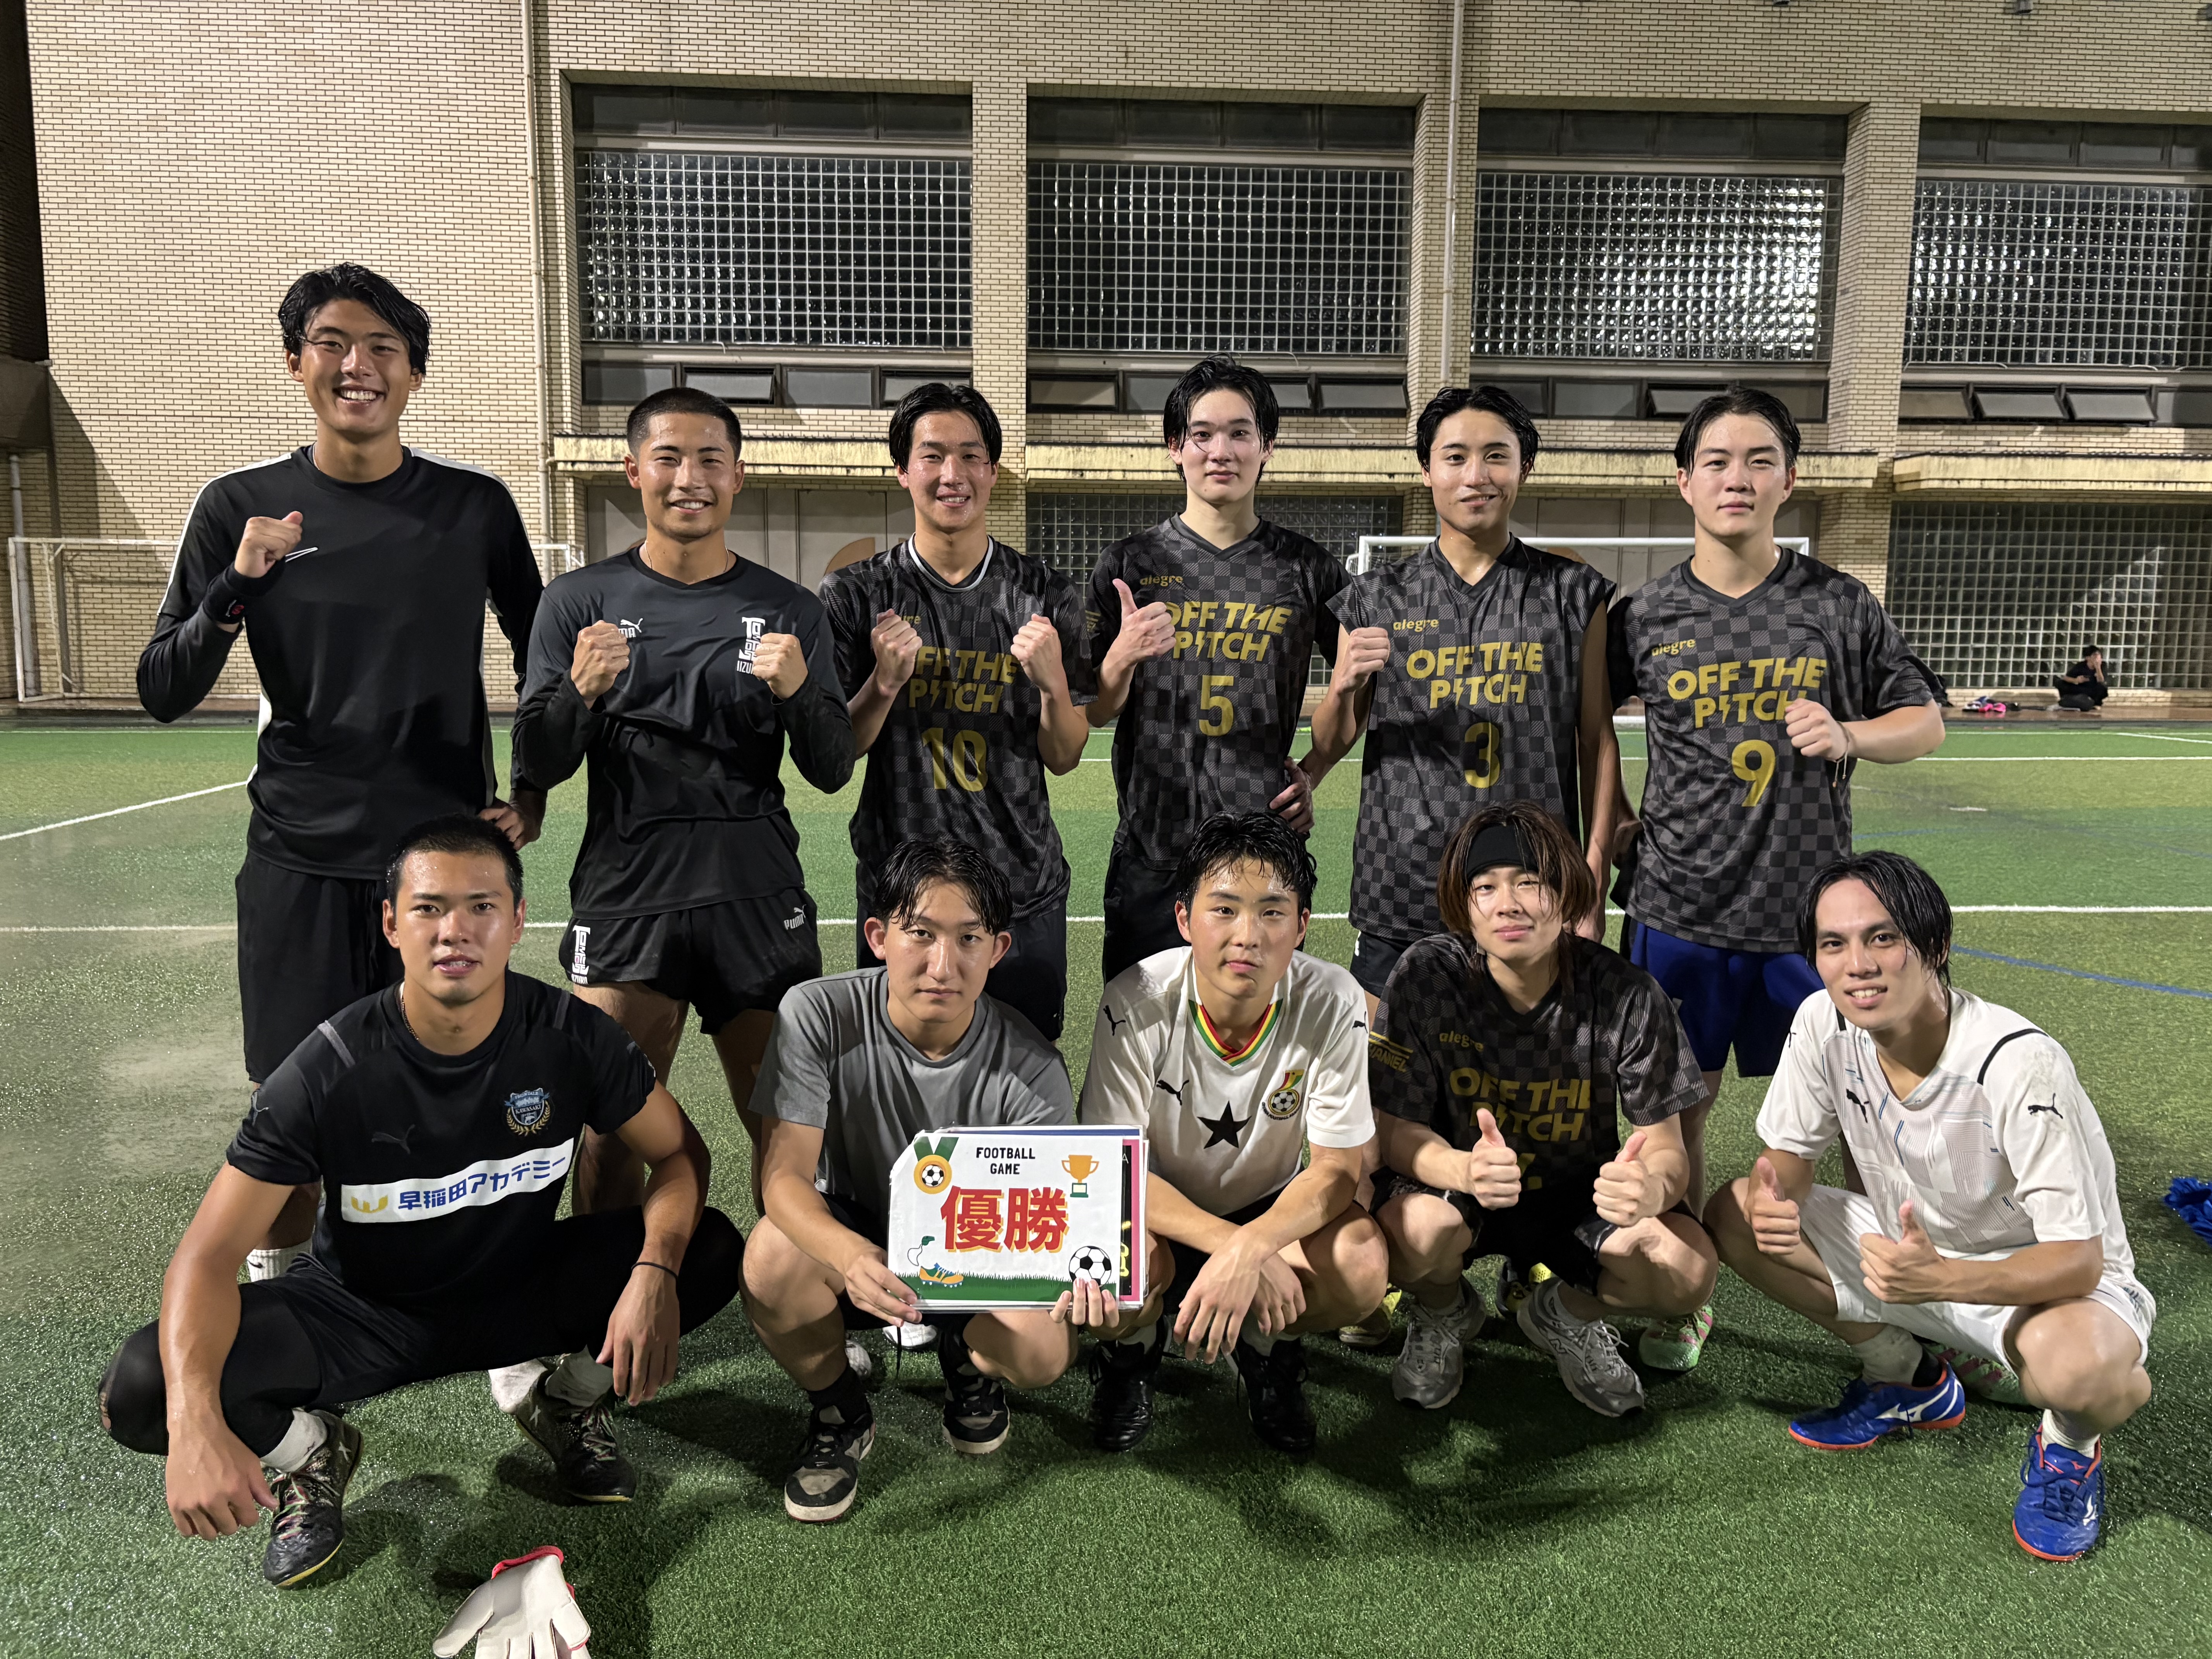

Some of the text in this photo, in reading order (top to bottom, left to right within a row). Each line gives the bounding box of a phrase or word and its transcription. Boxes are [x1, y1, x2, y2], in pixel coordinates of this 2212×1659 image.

[1140, 575, 1183, 587] alegre
[618, 627, 636, 638] MA
[1224, 603, 1292, 634] THE
[1393, 619, 1439, 632] alegre
[1173, 631, 1270, 661] PITCH
[1407, 642, 1544, 678] OFF THE
[1651, 639, 1695, 656] alegre
[915, 646, 1021, 684] FF THE
[1668, 657, 1826, 700] OFF THE
[908, 678, 1004, 713] PITCH
[1199, 675, 1234, 737] 5
[1429, 674, 1528, 708] PITCH
[922, 728, 988, 792] 10
[1464, 722, 1501, 788] 3
[1731, 740, 1775, 807] 9
[784, 914, 804, 930] PUMA
[1449, 1067, 1521, 1103] OFF
[515, 1104, 541, 1114] KAWASAKI
[976, 1147, 1036, 1159] FOOTBALL
[990, 1163, 1020, 1175] GAME
[398, 1156, 566, 1210] 早稲田アカデミー
[940, 1185, 1070, 1253] 優勝
